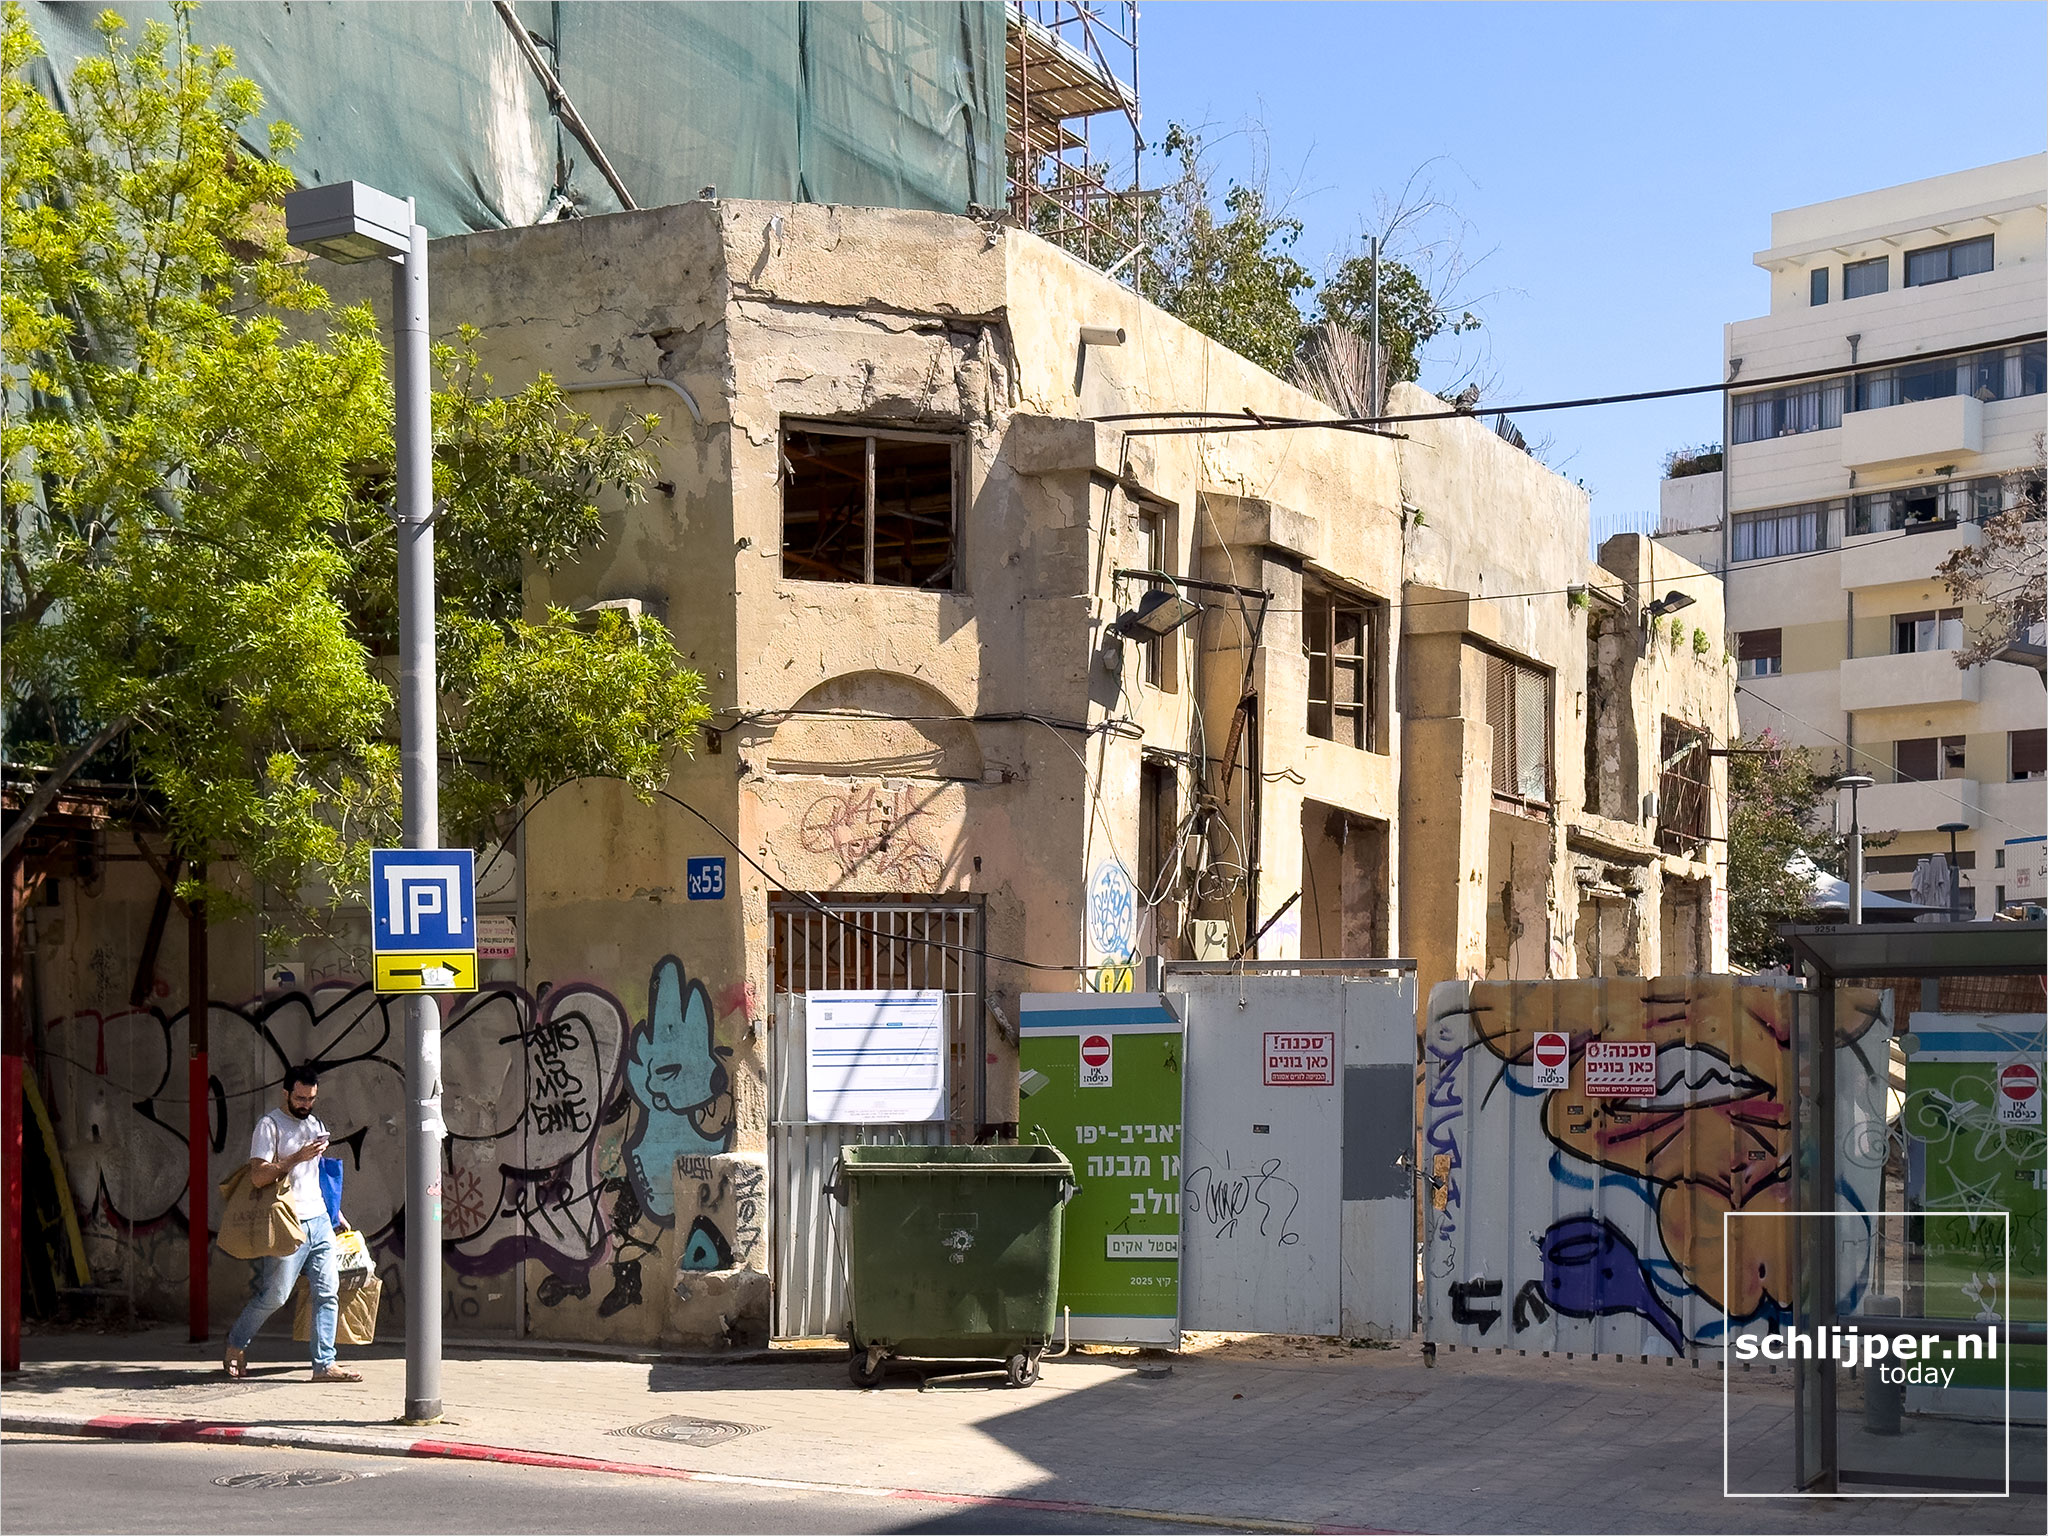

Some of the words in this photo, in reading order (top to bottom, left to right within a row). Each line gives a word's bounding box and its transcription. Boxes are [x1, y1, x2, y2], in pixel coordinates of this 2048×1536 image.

[1814, 925, 1837, 934] 9254
[1273, 1035, 1324, 1050] סכנה!
[1602, 1044, 1651, 1058] סכנה!
[1269, 1056, 1303, 1068] בונים
[1305, 1056, 1328, 1070] כאן
[1090, 1067, 1102, 1076] אין
[1545, 1067, 1557, 1076] אין
[1587, 1062, 1624, 1073] בונים
[1628, 1062, 1654, 1076] כאן
[1083, 1075, 1109, 1083] כניסה!
[1537, 1075, 1565, 1084] כניסה!
[2012, 1101, 2026, 1111] אין
[2003, 1109, 2037, 1119] כניסה!
[1087, 1155, 1151, 1177] מבנה
[1112, 1240, 1143, 1255] אקים
[1129, 1276, 1153, 1286] 2025
